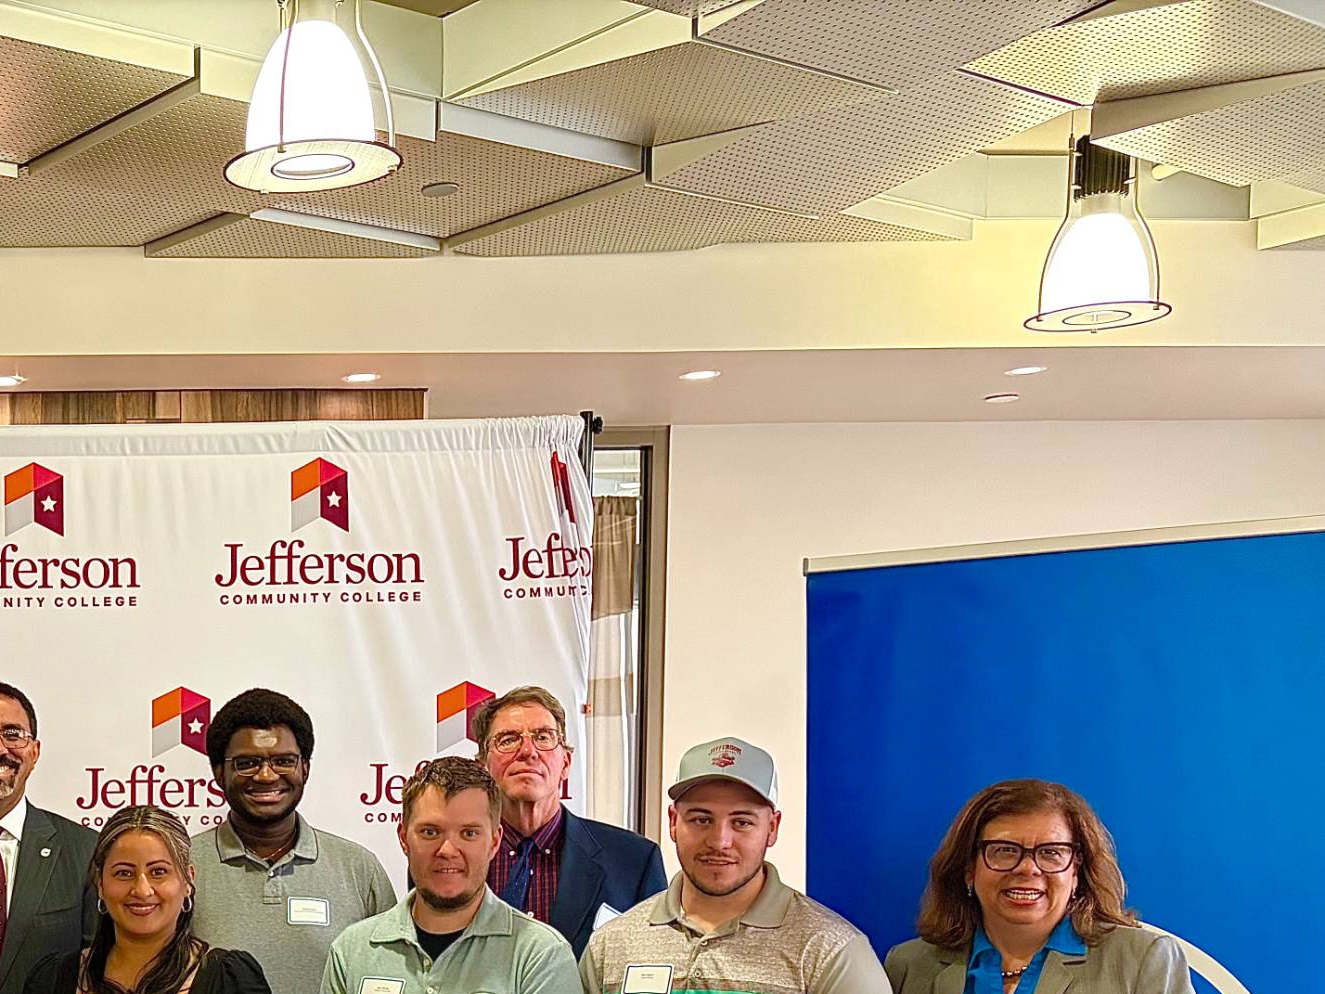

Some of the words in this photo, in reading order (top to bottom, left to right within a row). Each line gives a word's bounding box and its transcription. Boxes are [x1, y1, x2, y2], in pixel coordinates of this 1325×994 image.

[215, 539, 425, 587] Jefferson
[54, 596, 137, 607] COLLEGE
[220, 592, 331, 605] COMMUNITY
[340, 591, 421, 602] COLLEGE
[76, 764, 225, 810] Jeffers
